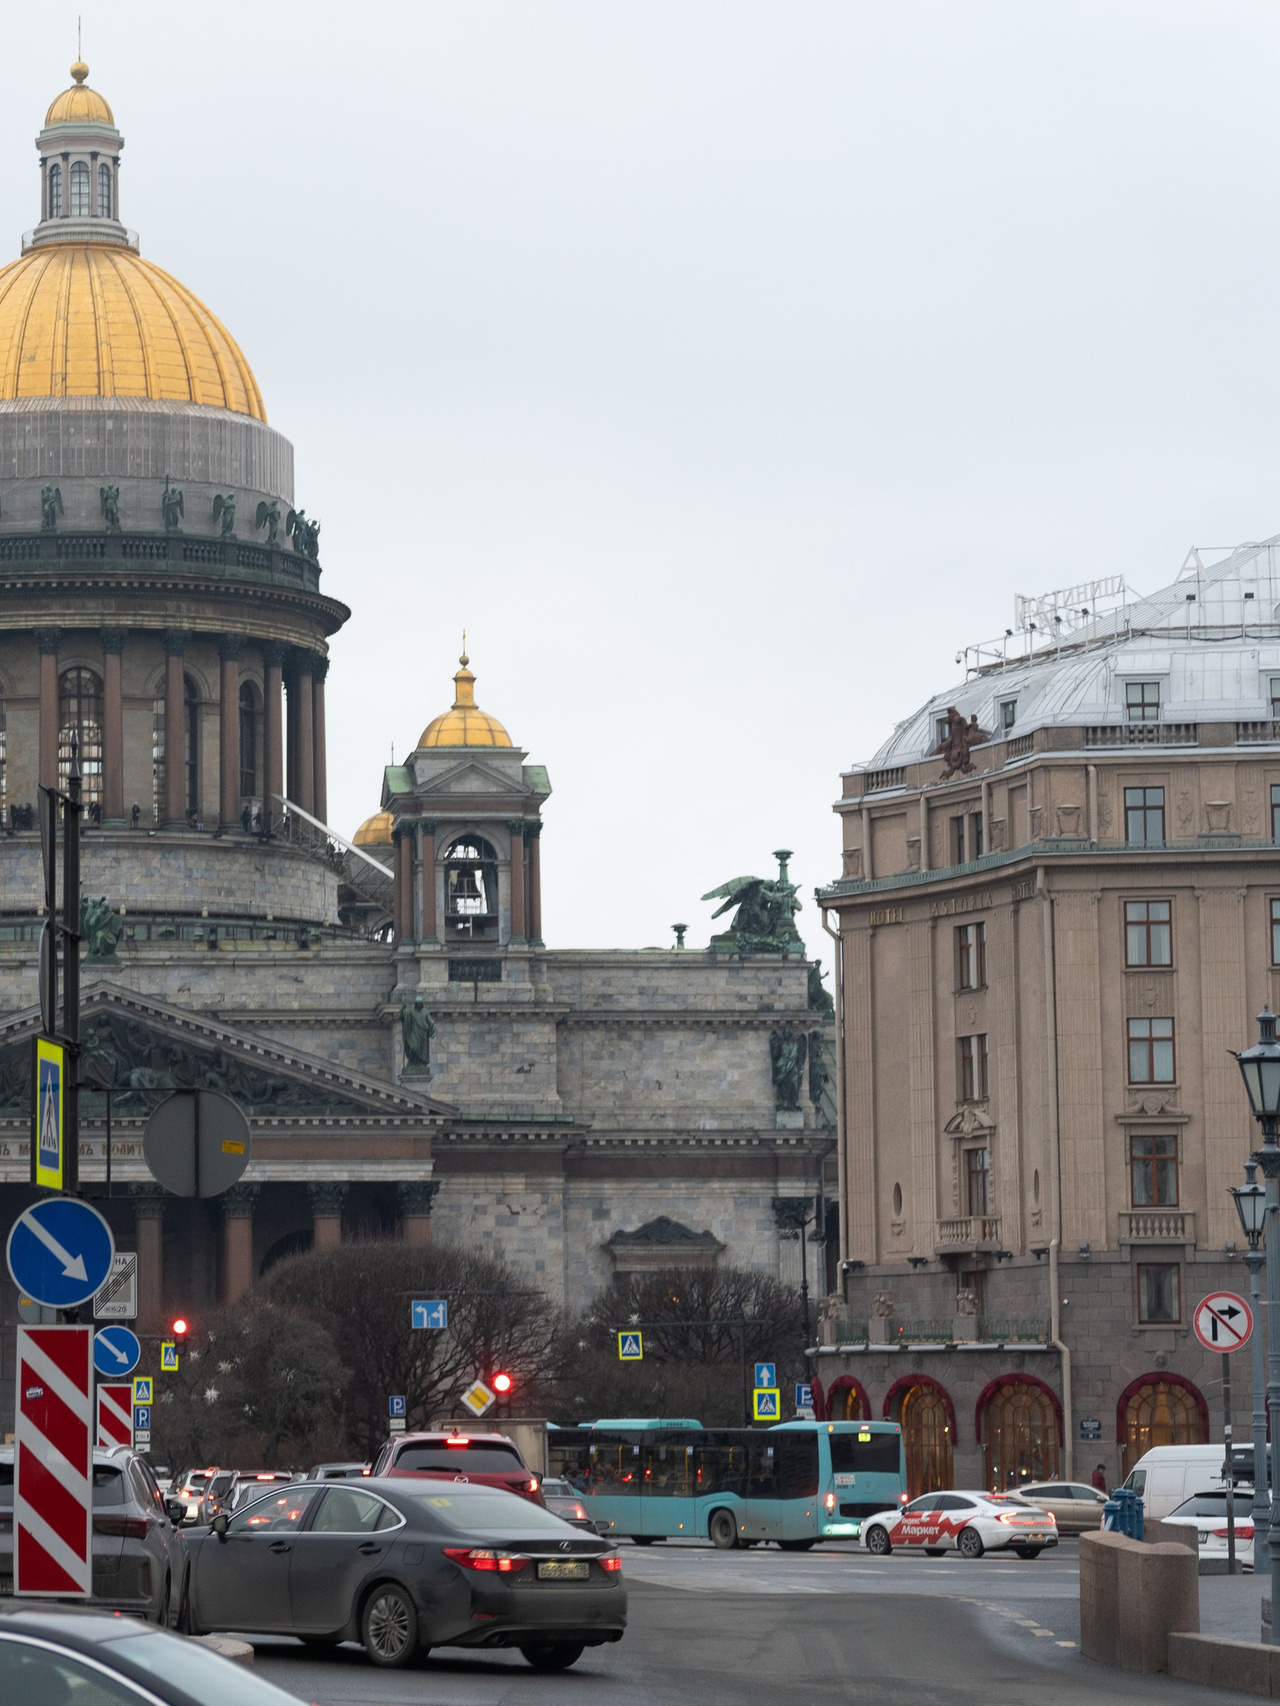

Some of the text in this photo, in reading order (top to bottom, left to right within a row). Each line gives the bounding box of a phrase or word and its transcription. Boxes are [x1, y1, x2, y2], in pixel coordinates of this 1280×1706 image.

[870, 892, 993, 926] HOTEL ASTORIA
[115, 1257, 127, 1266] НА
[901, 1525, 940, 1536] Маркет
